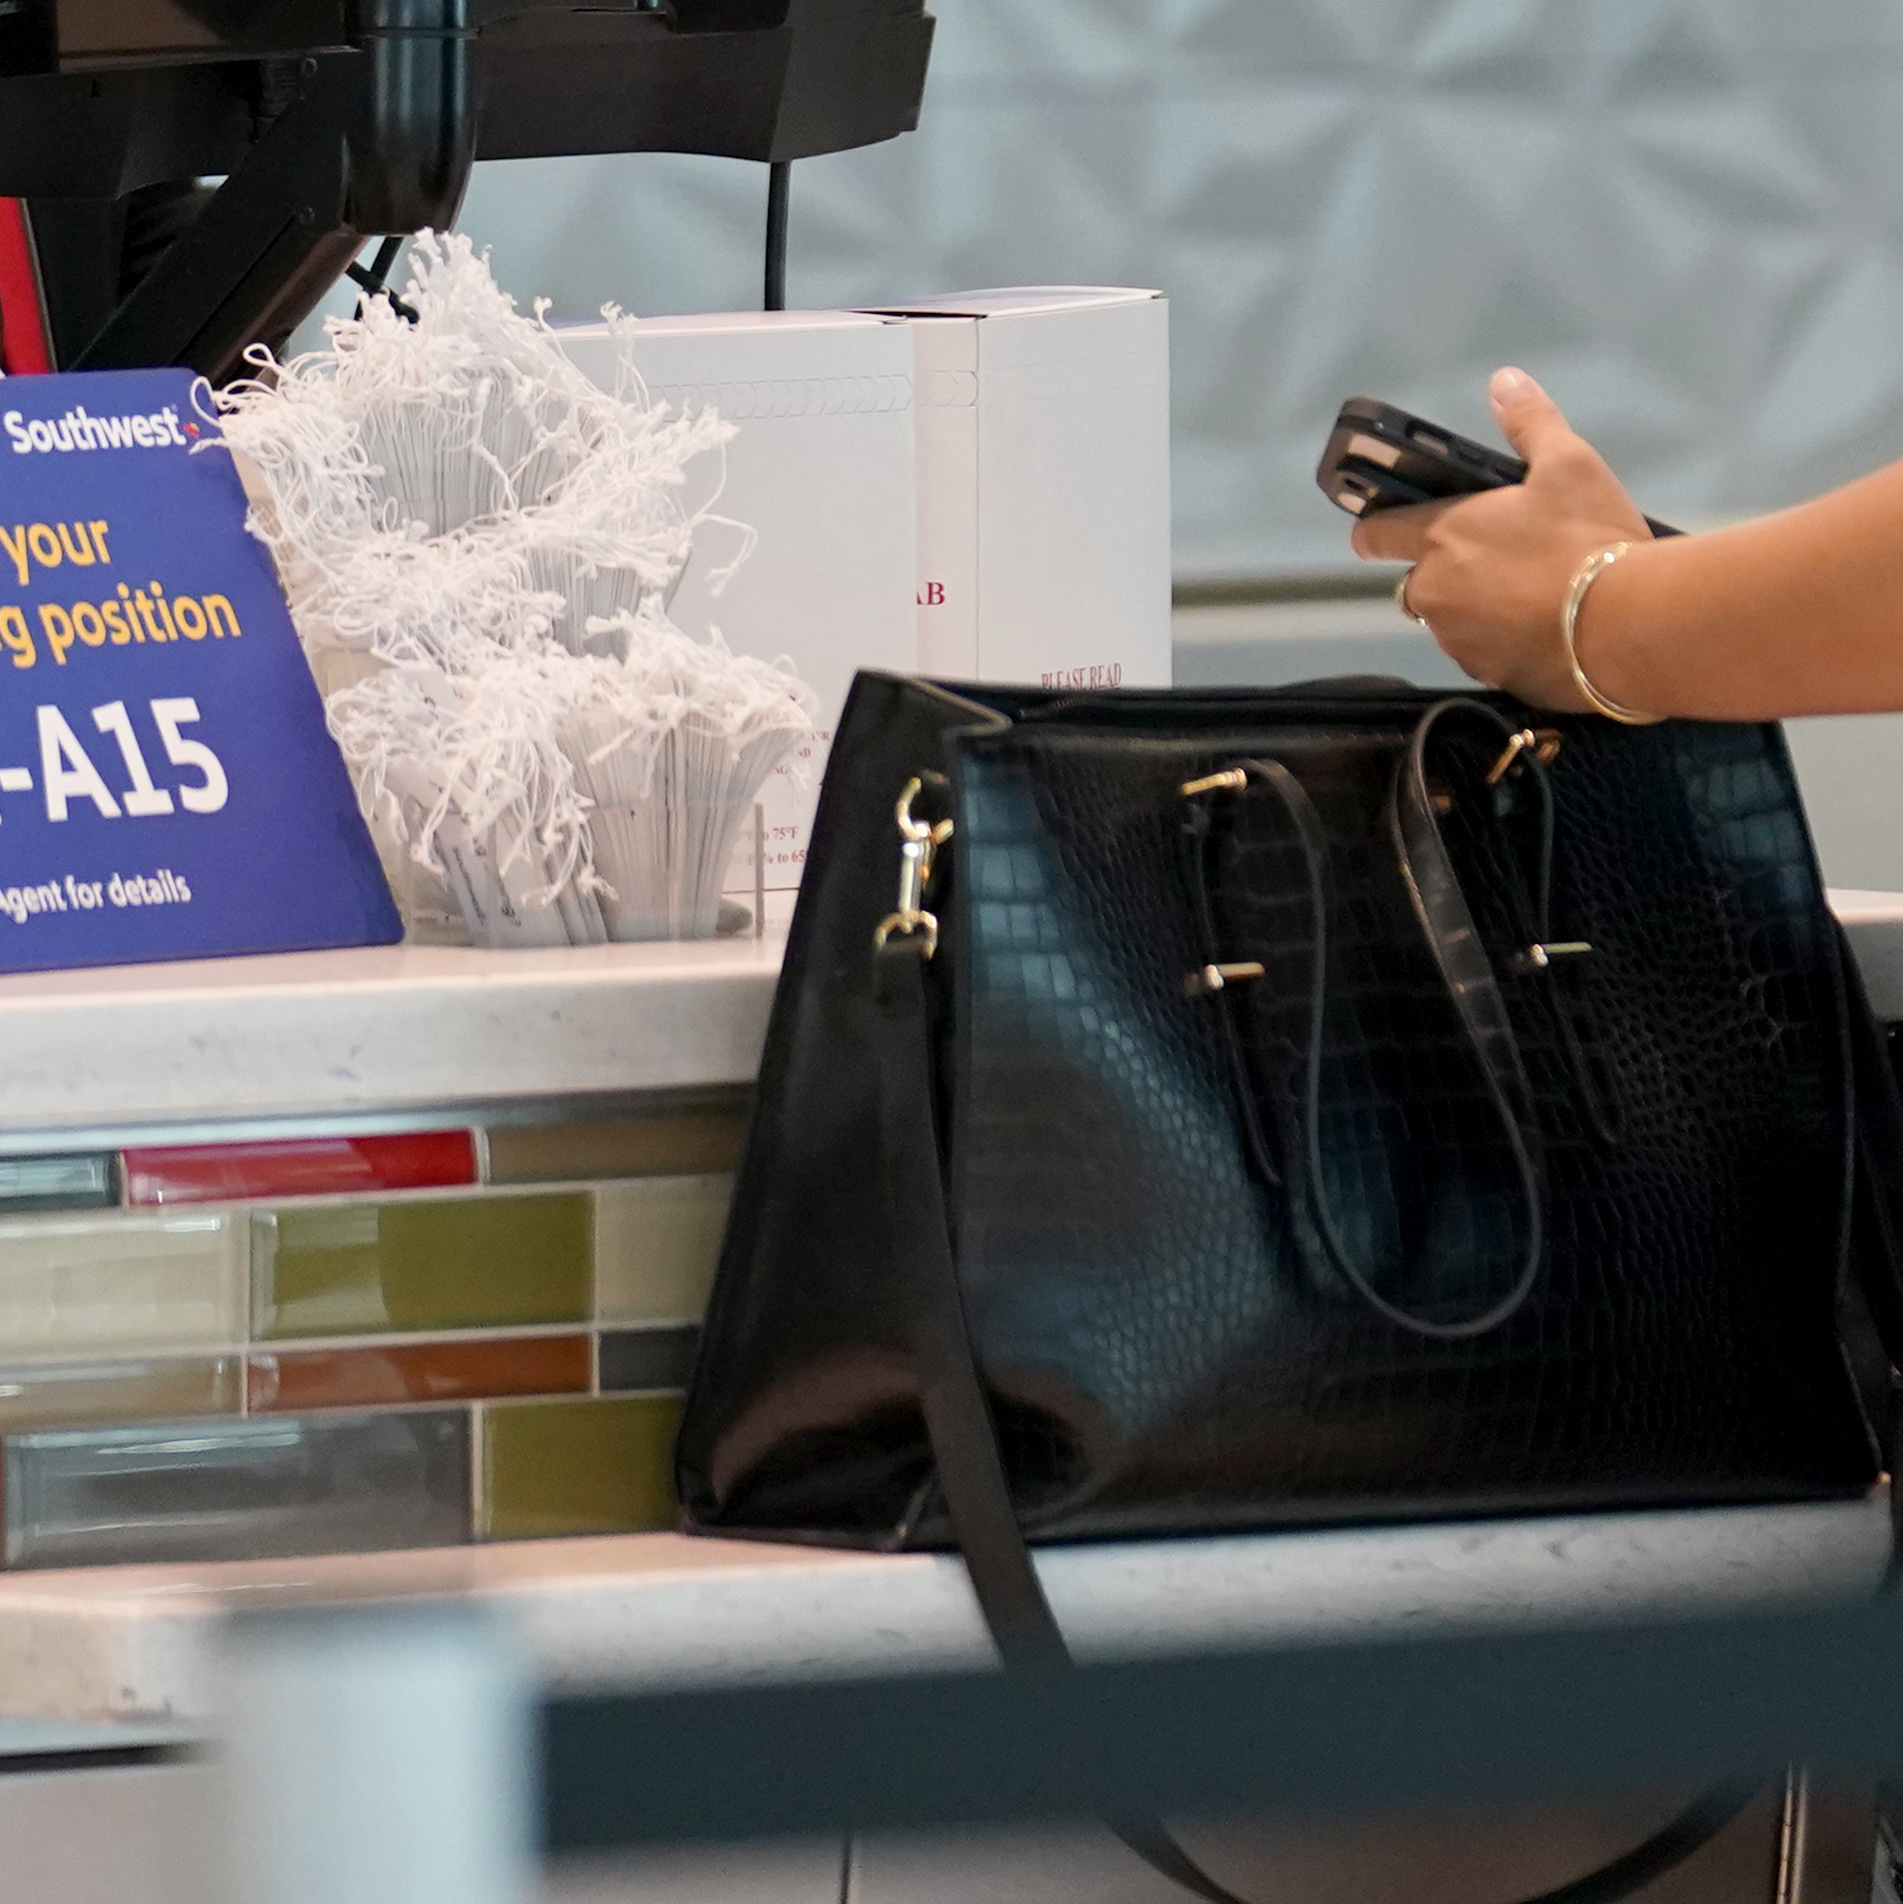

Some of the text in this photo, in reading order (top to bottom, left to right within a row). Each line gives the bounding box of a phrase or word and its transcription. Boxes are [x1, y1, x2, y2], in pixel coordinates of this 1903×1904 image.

[3, 404, 187, 454] Southwest
[38, 580, 242, 665] position
[1041, 662, 1122, 690] PLEASE READ
[773, 827, 800, 841] 75°F
[777, 853, 789, 864] to
[63, 875, 104, 910] for
[108, 869, 192, 908] details
